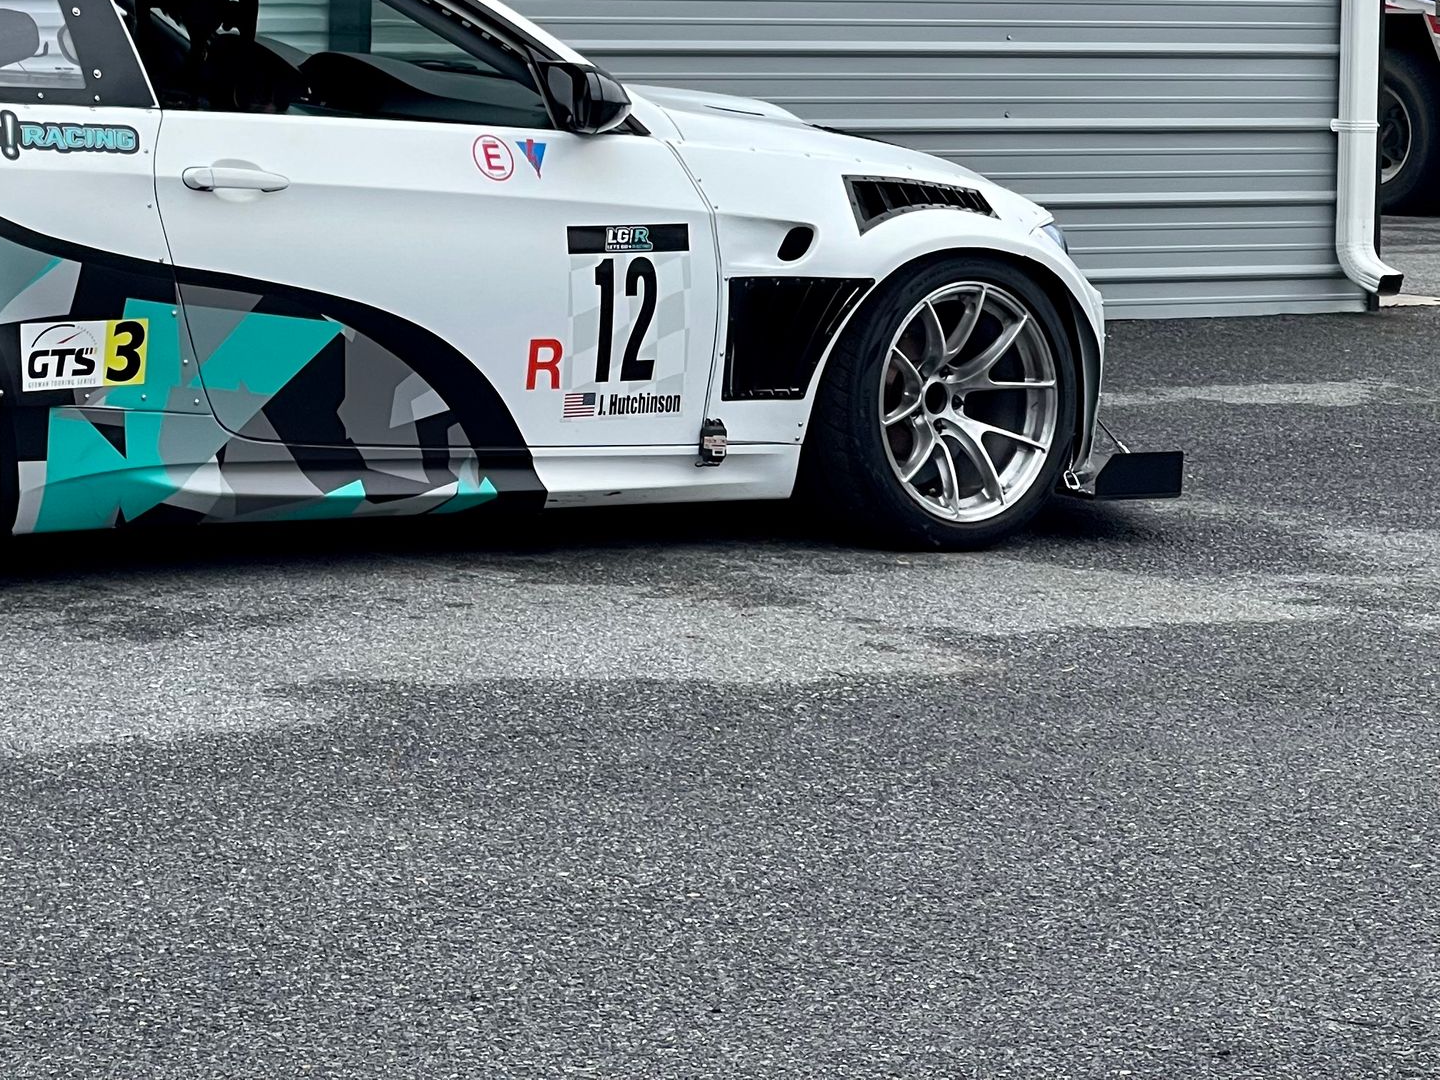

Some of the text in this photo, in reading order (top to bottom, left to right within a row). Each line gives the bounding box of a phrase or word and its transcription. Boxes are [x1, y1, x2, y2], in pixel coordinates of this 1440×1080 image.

[20, 124, 136, 151] RACING
[482, 143, 505, 170] E
[595, 256, 658, 383] 12
[28, 320, 146, 382] GTS 3
[526, 338, 564, 391] R
[598, 392, 681, 416] J. Hutchinson
